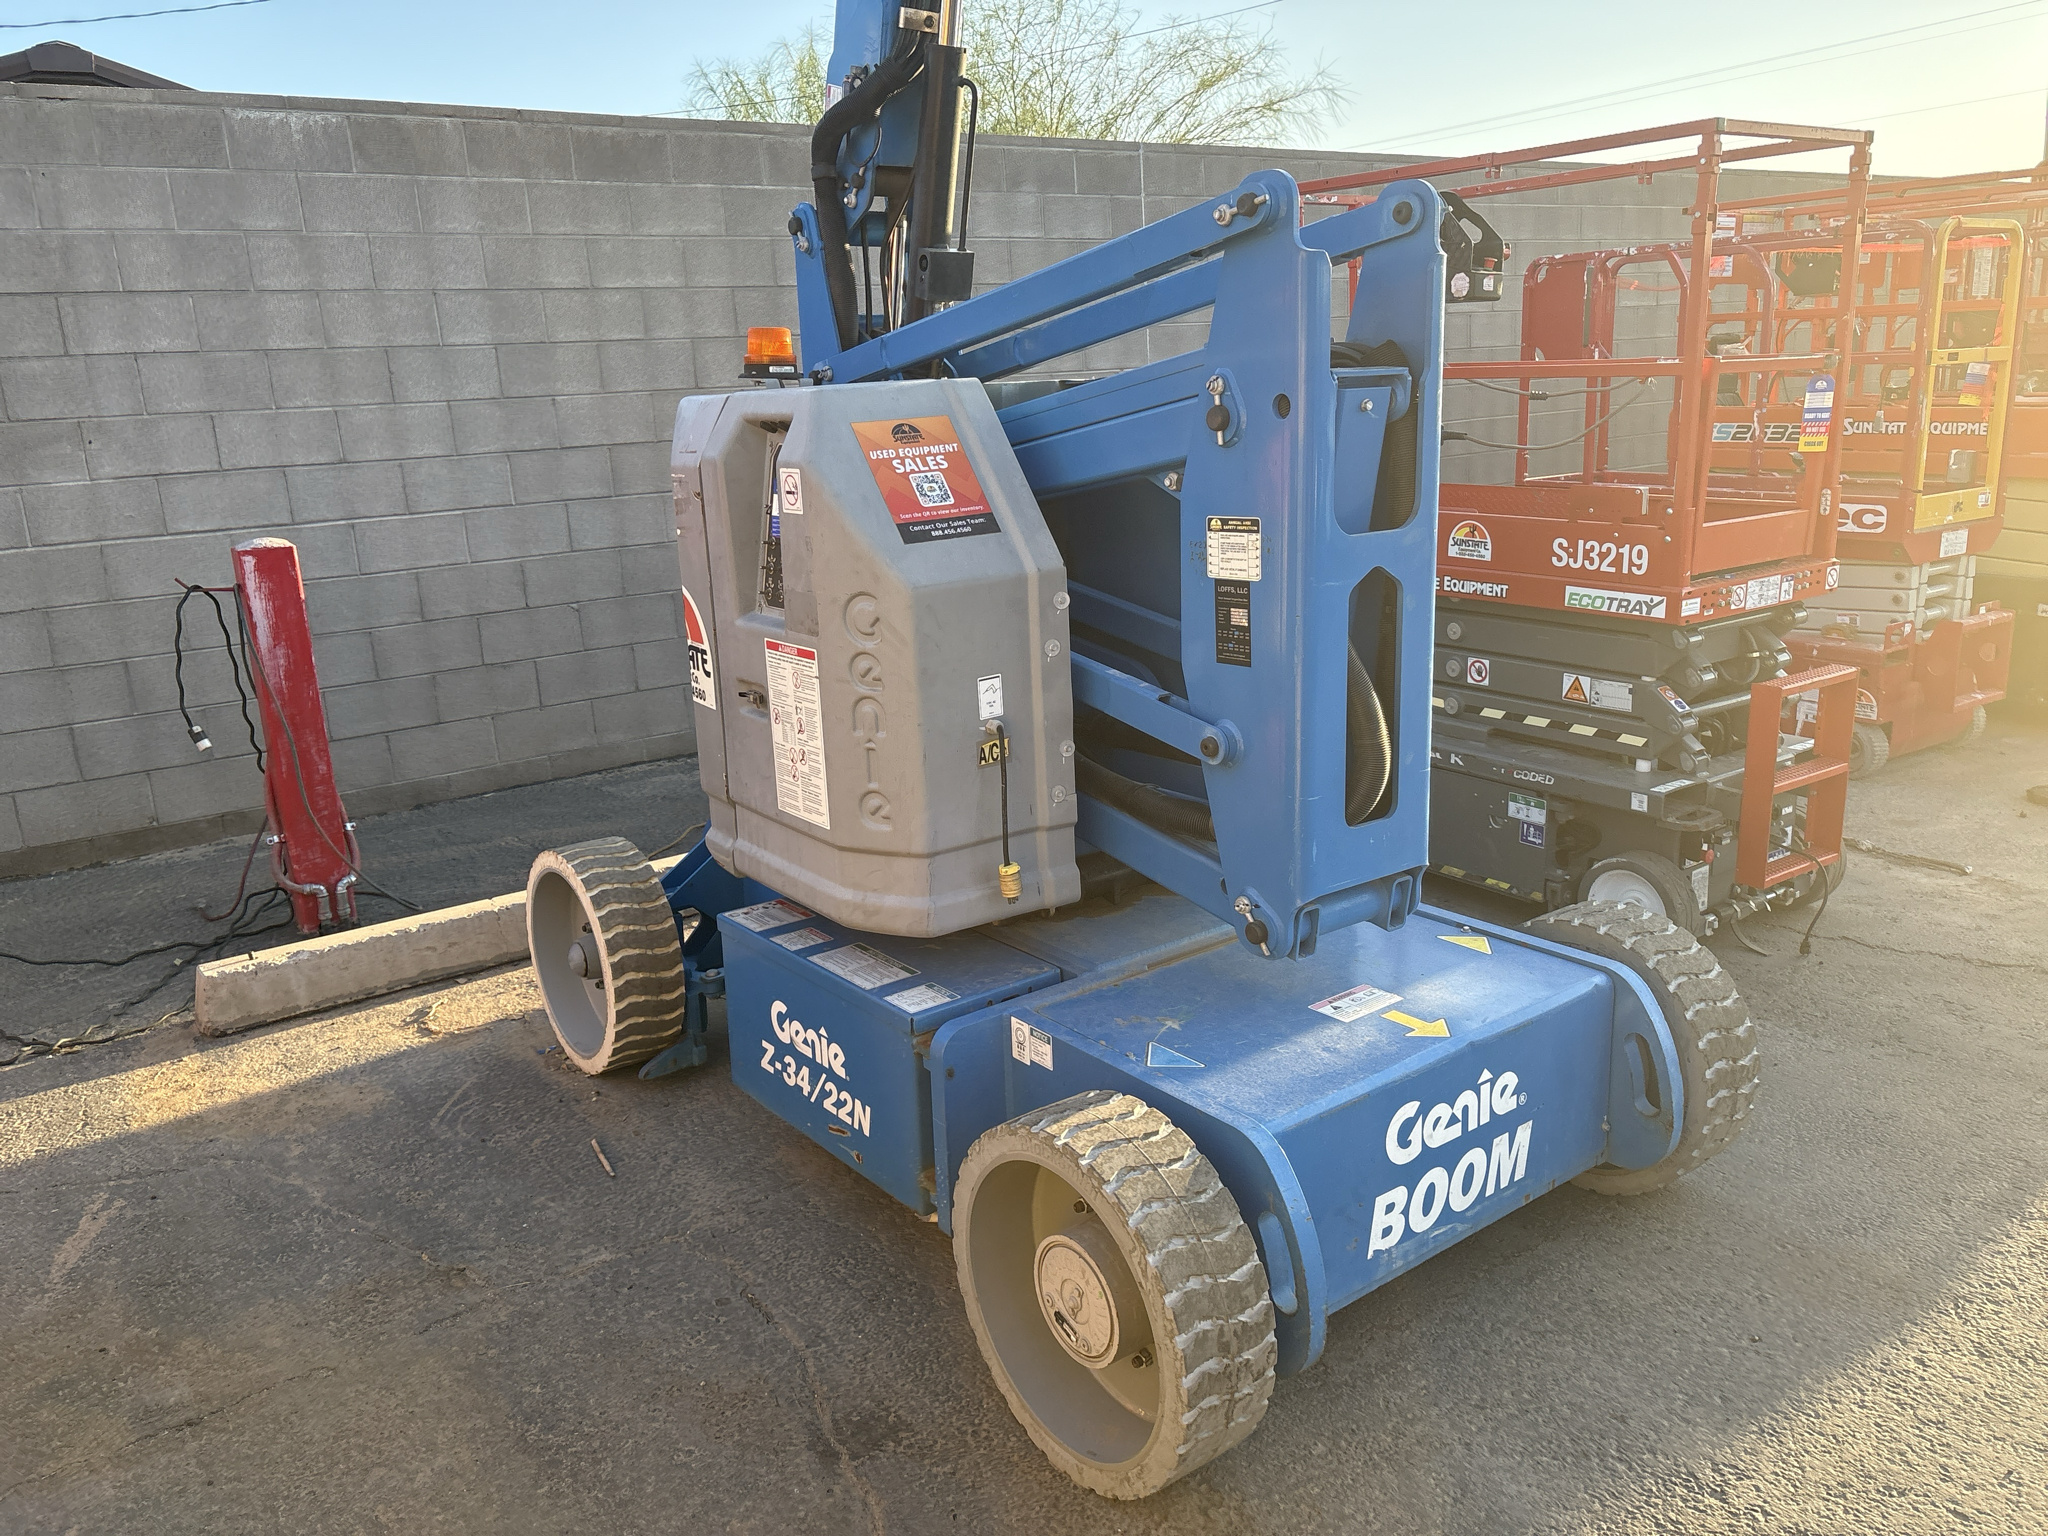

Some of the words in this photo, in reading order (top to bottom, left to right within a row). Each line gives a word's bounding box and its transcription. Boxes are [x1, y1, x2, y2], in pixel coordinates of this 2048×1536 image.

[1843, 418, 1907, 435] SUNTAT
[870, 449, 896, 460] USED
[899, 443, 958, 458] EQUIPMENT
[892, 455, 949, 474] SALES
[909, 523, 934, 532] Contact
[936, 521, 948, 529] Our
[1451, 537, 1489, 551] SUNSTATE
[1551, 537, 1649, 575] SJ3219
[1237, 587, 1248, 595] LLC
[1443, 575, 1509, 598] EQUIPMENT
[1566, 592, 1665, 616] ECOTRAY
[843, 591, 892, 832] Genie
[771, 1000, 846, 1080] Genie
[760, 1039, 871, 1138] Z-34/22N
[1385, 1067, 1519, 1165] Genie
[1366, 1119, 1533, 1260] BOOM
